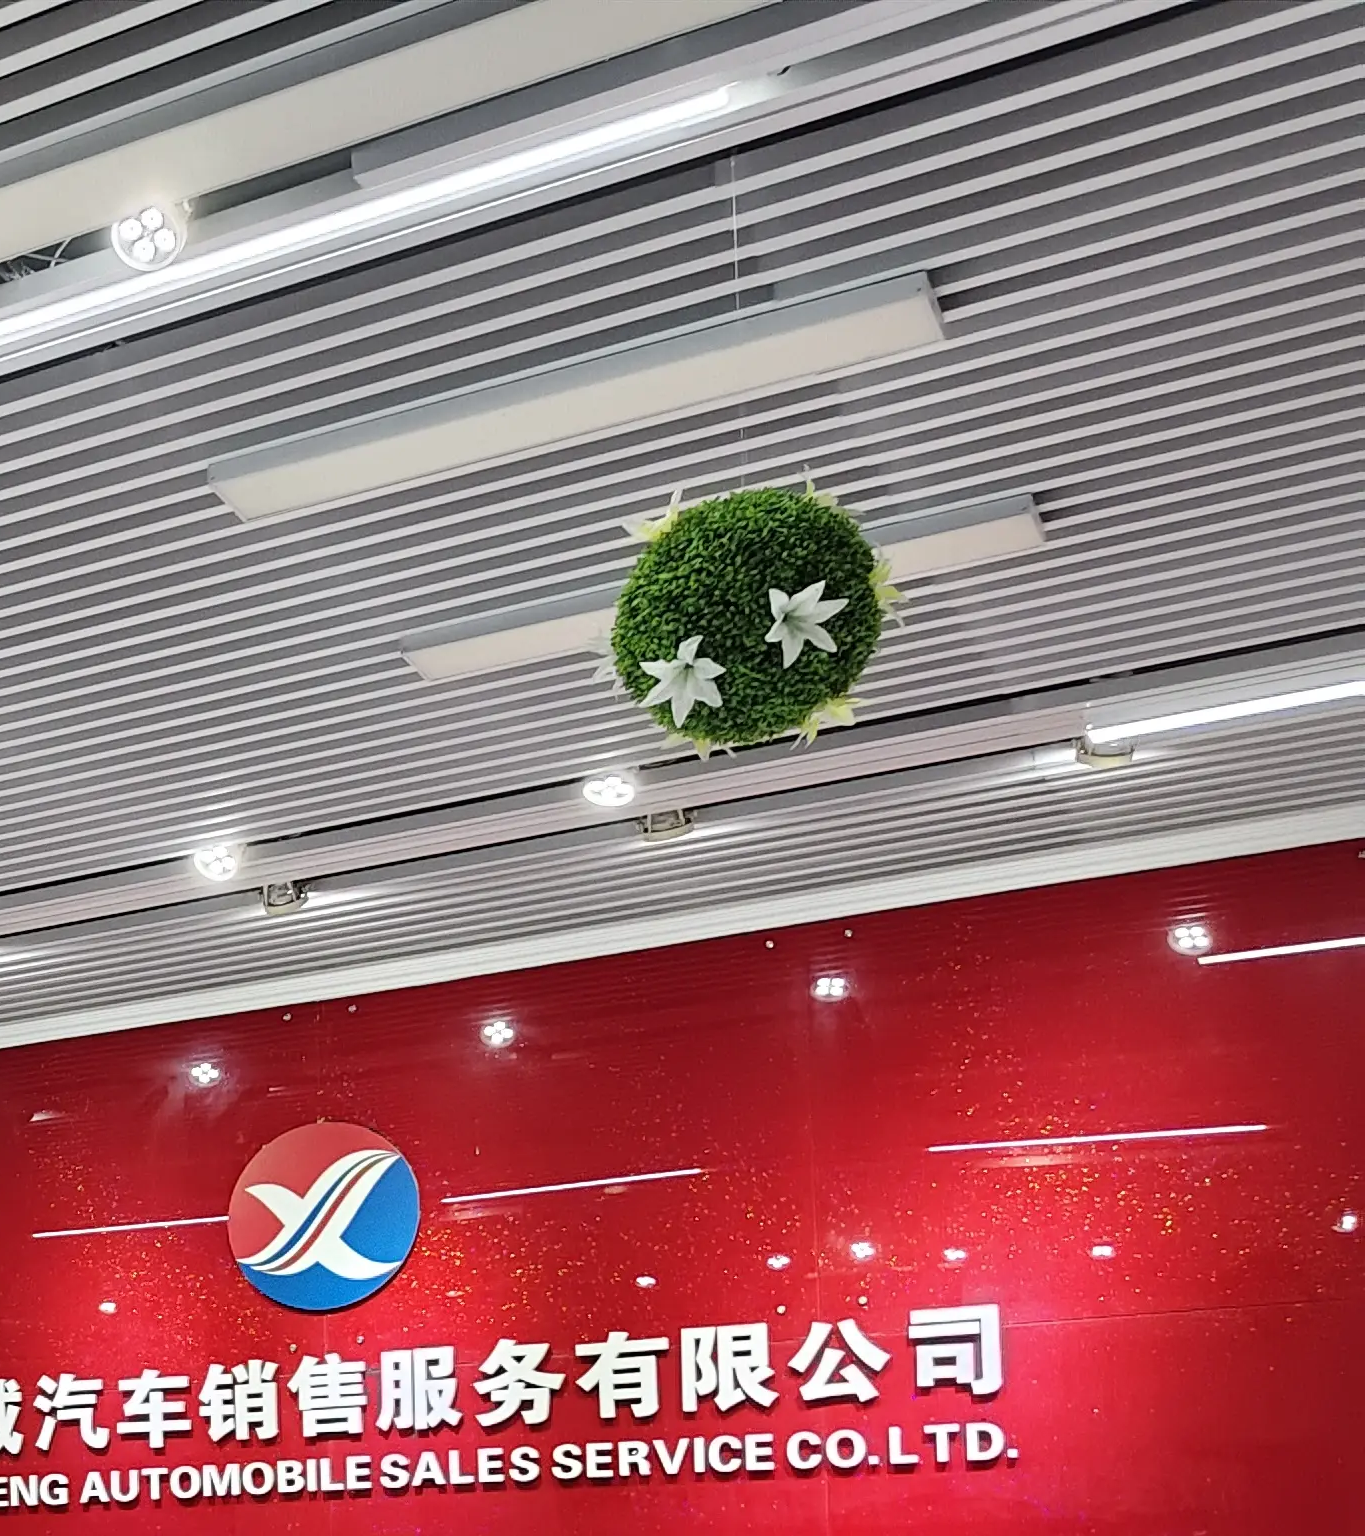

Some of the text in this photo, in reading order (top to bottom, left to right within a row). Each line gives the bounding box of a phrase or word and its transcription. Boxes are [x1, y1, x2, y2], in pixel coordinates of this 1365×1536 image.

[79, 1453, 371, 1505] AUTOMOBILE
[379, 1442, 541, 1490] SALES
[550, 1432, 776, 1481] SERVICE
